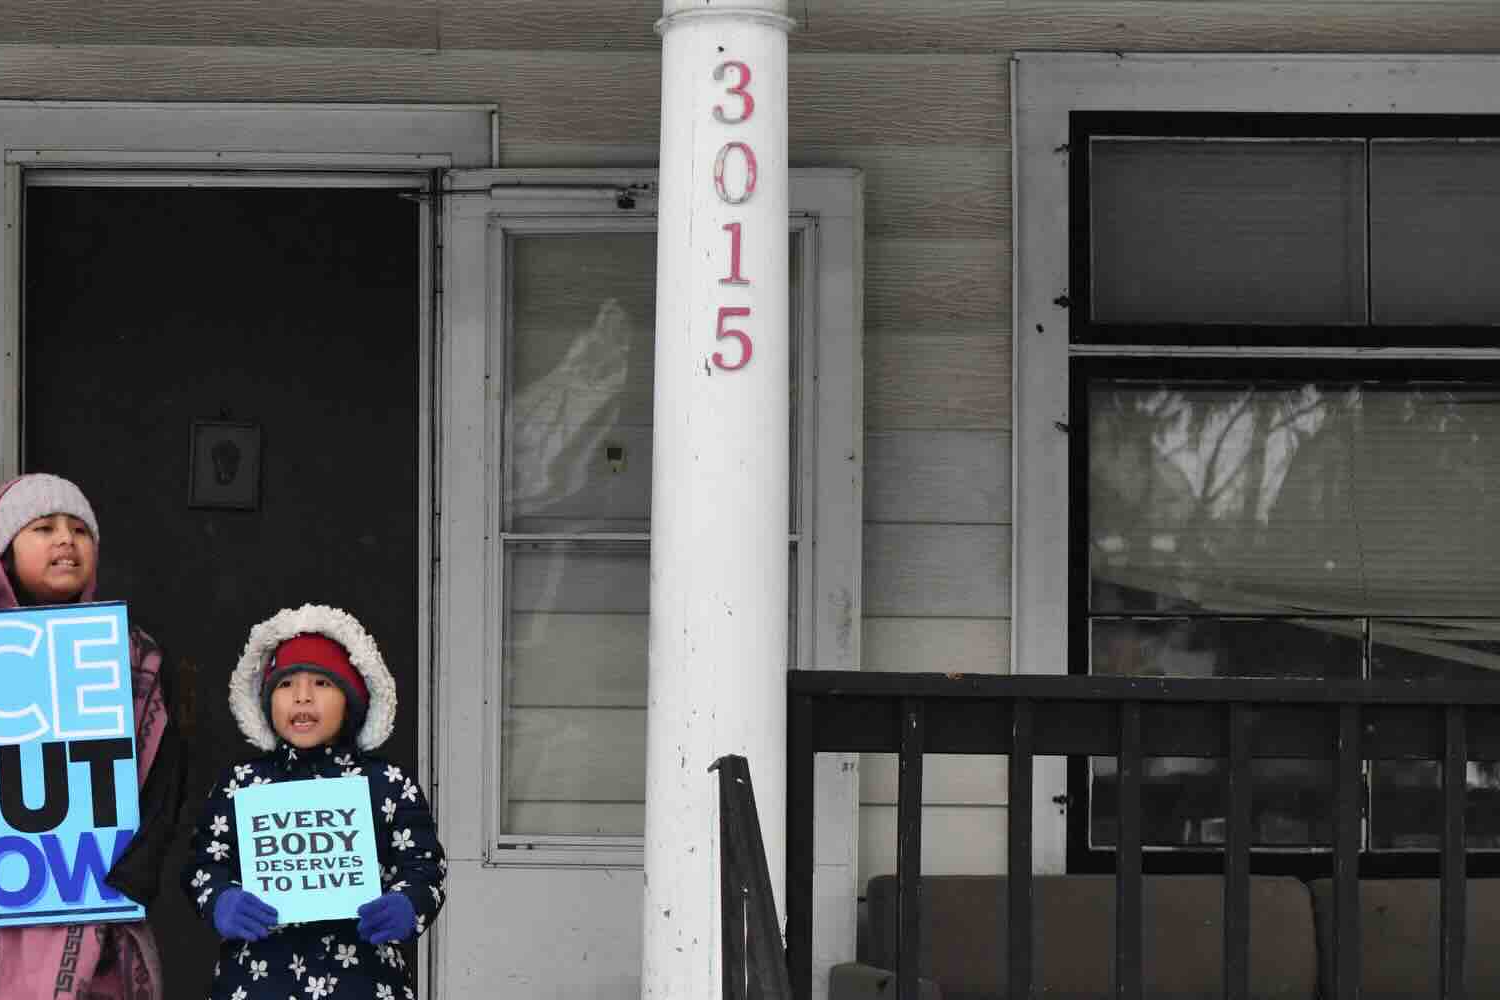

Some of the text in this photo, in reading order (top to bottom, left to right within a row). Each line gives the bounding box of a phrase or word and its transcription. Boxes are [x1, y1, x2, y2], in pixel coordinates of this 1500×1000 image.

[711, 60, 758, 371] 3015
[252, 808, 356, 832] EVERY
[252, 830, 360, 857] BODY
[255, 855, 363, 872] DESERVES
[257, 871, 364, 892] TO LIVE
